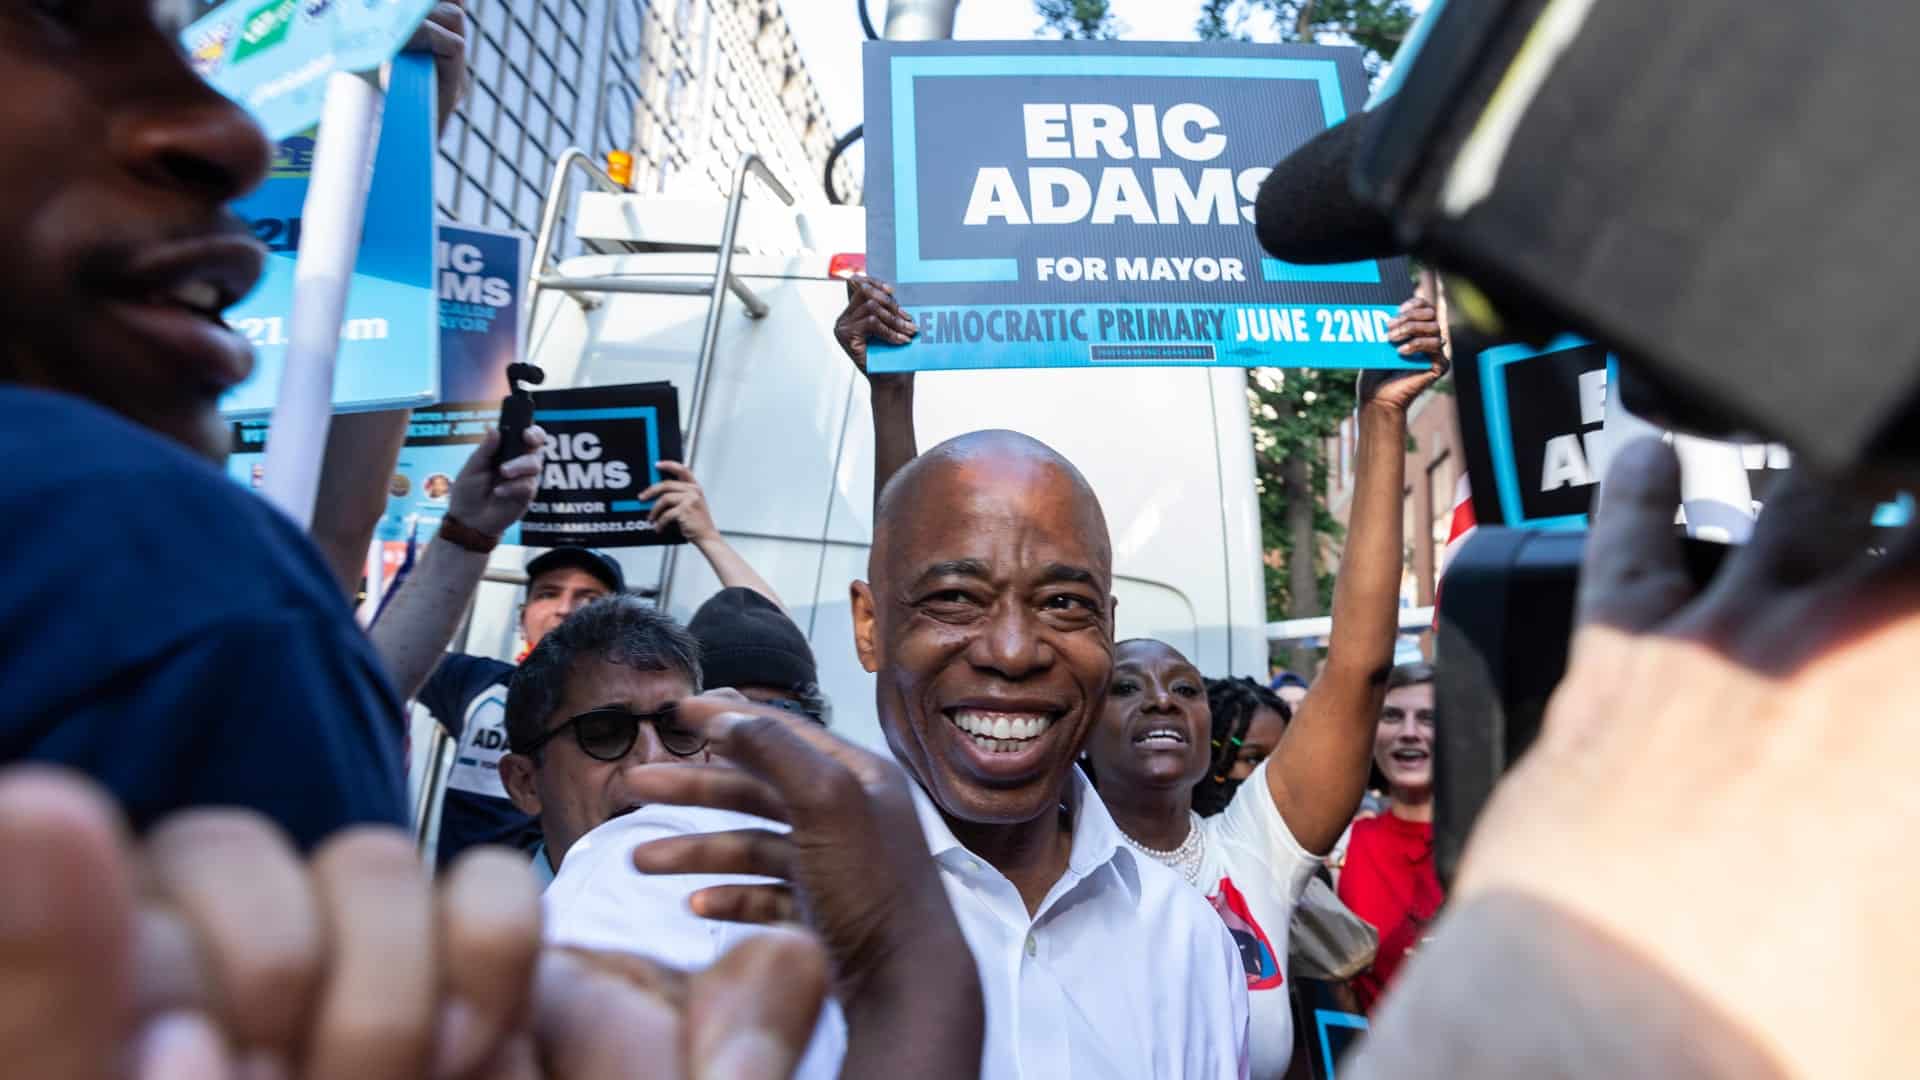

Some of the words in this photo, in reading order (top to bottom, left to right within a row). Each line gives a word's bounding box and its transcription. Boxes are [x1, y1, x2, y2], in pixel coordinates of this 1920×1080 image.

[1022, 102, 1228, 161] ERIC
[1036, 257, 1109, 282] FOR
[1115, 257, 1247, 282] MAYOR
[918, 308, 1089, 345] EMOCRATIC
[1098, 307, 1225, 342] PRIMARY
[1235, 307, 1311, 342] JUNE
[1315, 308, 1392, 343] 22ND
[543, 432, 603, 461] RIC
[542, 460, 632, 490] AMS
[528, 501, 549, 513] OR
[551, 501, 606, 513] MAYOR
